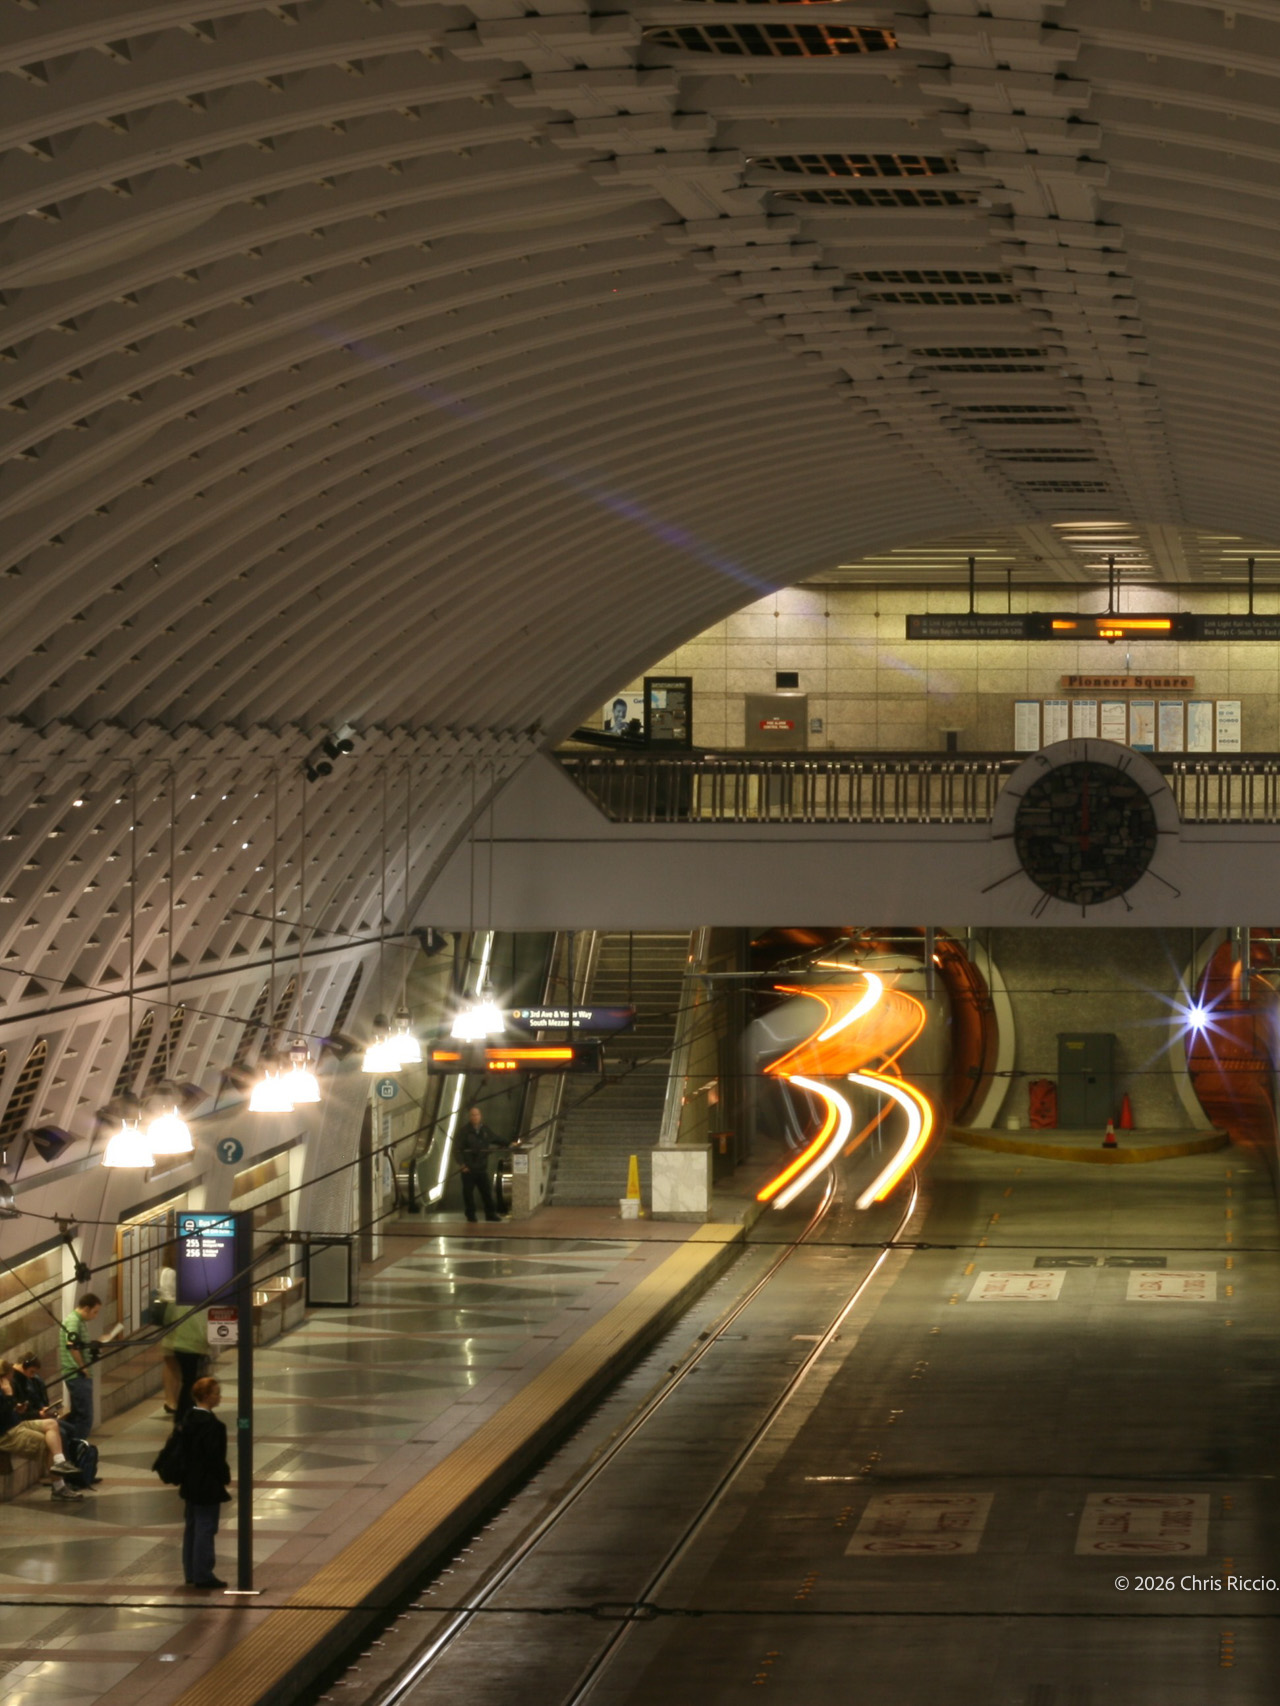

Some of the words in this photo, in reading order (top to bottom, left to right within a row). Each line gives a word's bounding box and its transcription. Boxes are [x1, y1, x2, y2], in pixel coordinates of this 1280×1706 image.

[1068, 676, 1127, 687] Pioneer
[1134, 676, 1188, 688] Square
[578, 1011, 592, 1020] Way
[530, 1019, 547, 1027] South
[198, 1219, 211, 1227] Bus
[186, 1248, 201, 1257] 256
